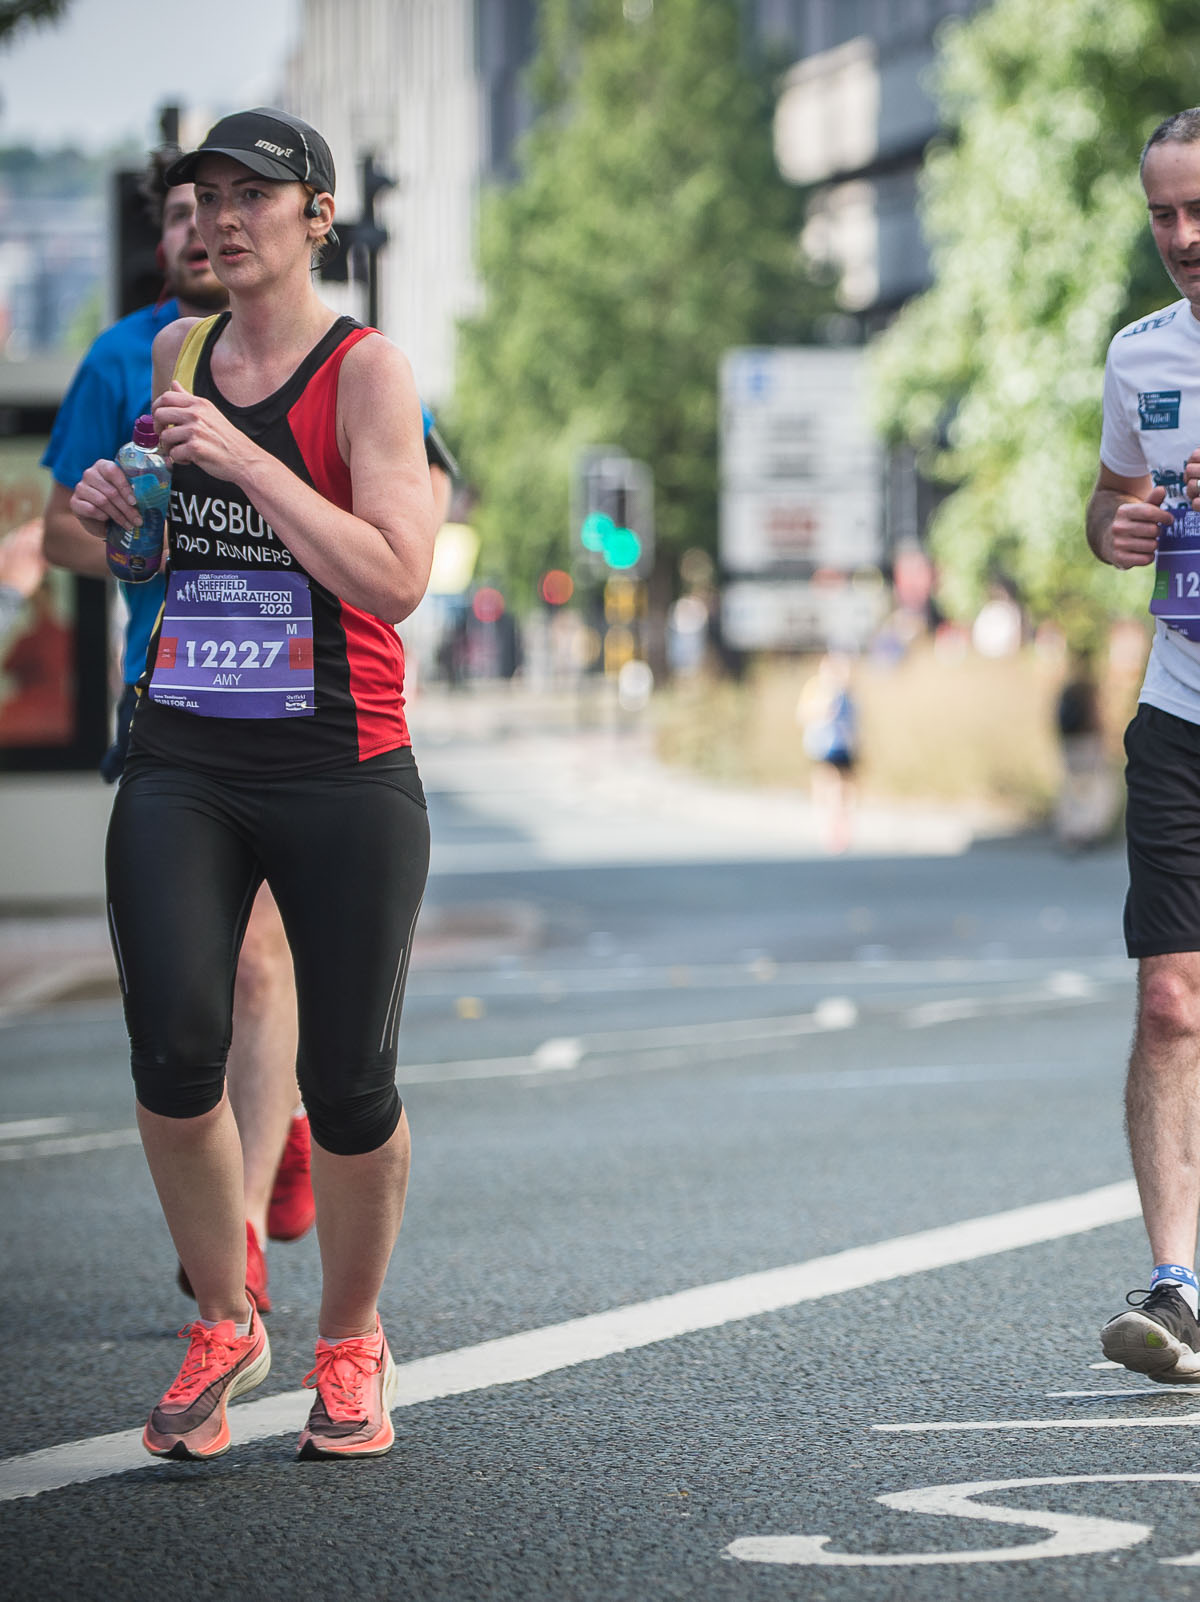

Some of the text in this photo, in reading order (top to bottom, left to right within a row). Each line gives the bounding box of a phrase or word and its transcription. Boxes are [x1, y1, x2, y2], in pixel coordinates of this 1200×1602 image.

[168, 490, 274, 540] EWSBU
[216, 540, 292, 566] RUNNERS
[199, 580, 245, 590] SHEFFIELD
[200, 591, 291, 602] HALF MARATHON
[259, 604, 292, 615] 2020
[286, 624, 298, 635] M
[185, 640, 284, 669] 12227
[212, 674, 242, 685] AMY
